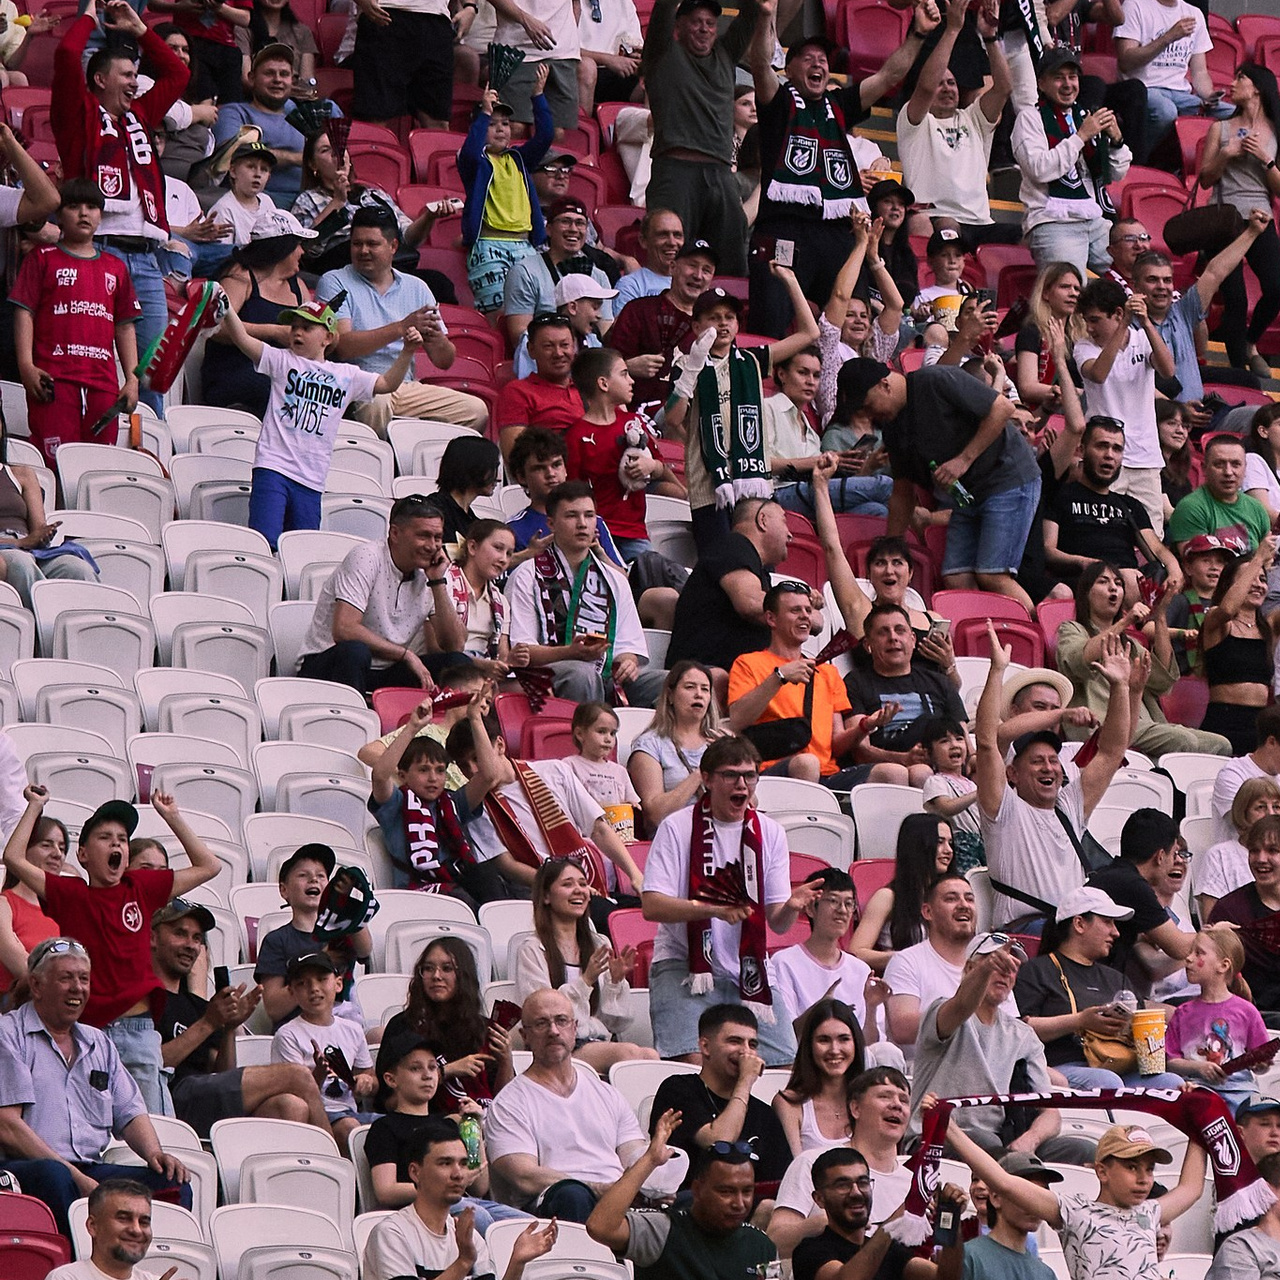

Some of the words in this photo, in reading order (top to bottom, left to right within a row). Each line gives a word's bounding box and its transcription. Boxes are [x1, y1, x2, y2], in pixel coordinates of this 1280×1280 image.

[56, 268, 78, 279] FON
[70, 300, 107, 312] КАЗАНЬ
[285, 369, 347, 409] Summer
[292, 399, 329, 437] VIBE
[737, 457, 767, 474] 1958
